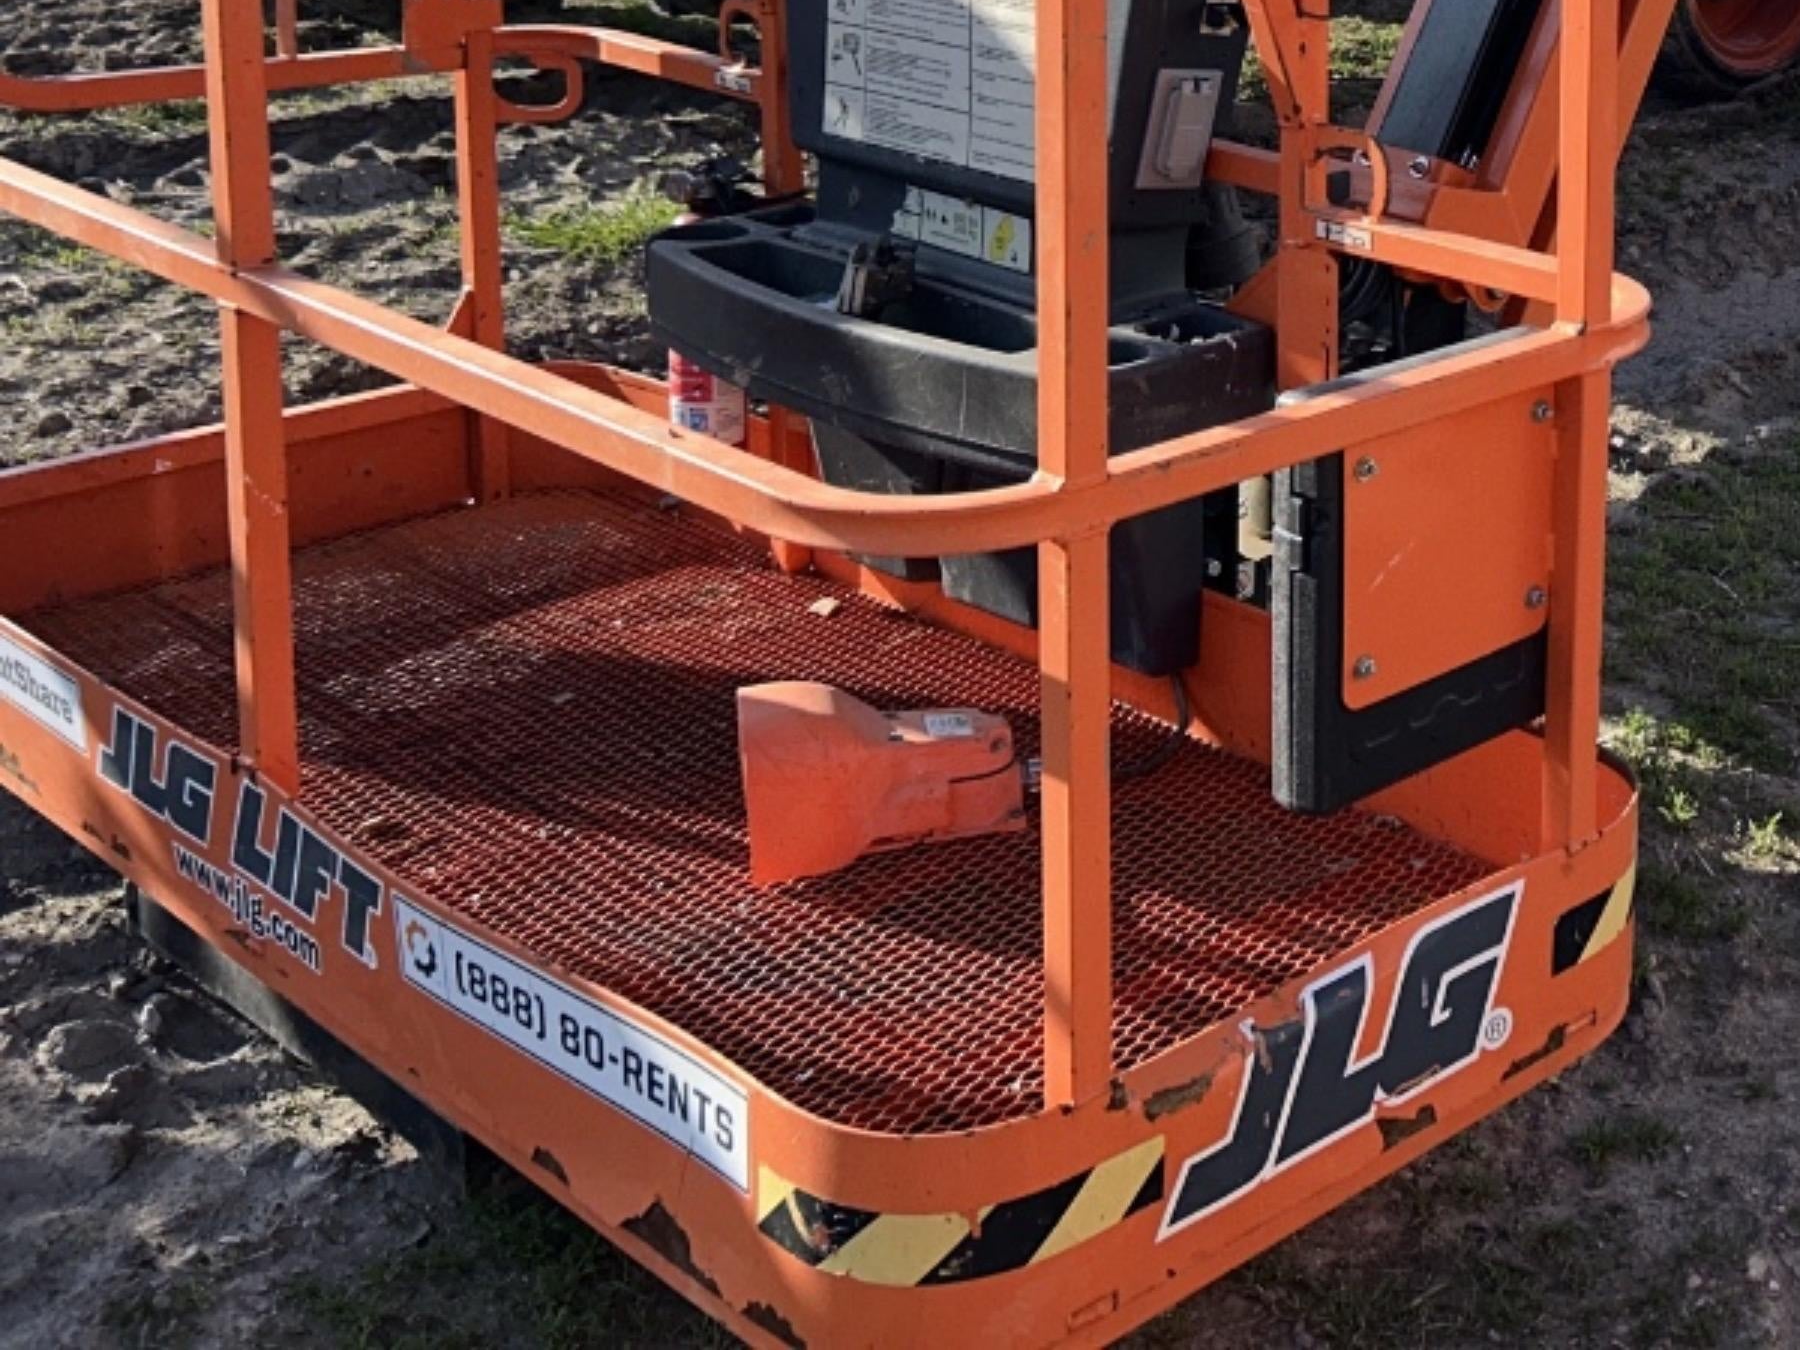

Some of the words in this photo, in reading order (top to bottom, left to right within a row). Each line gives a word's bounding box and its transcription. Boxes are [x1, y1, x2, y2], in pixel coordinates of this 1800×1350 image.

[98, 703, 218, 849] JLG
[230, 775, 385, 970] LIFT
[173, 842, 322, 976] www.jlg.com
[453, 949, 548, 1043] (888)
[558, 1012, 735, 1153] 80-RENTS
[1154, 877, 1526, 1246] JLG
